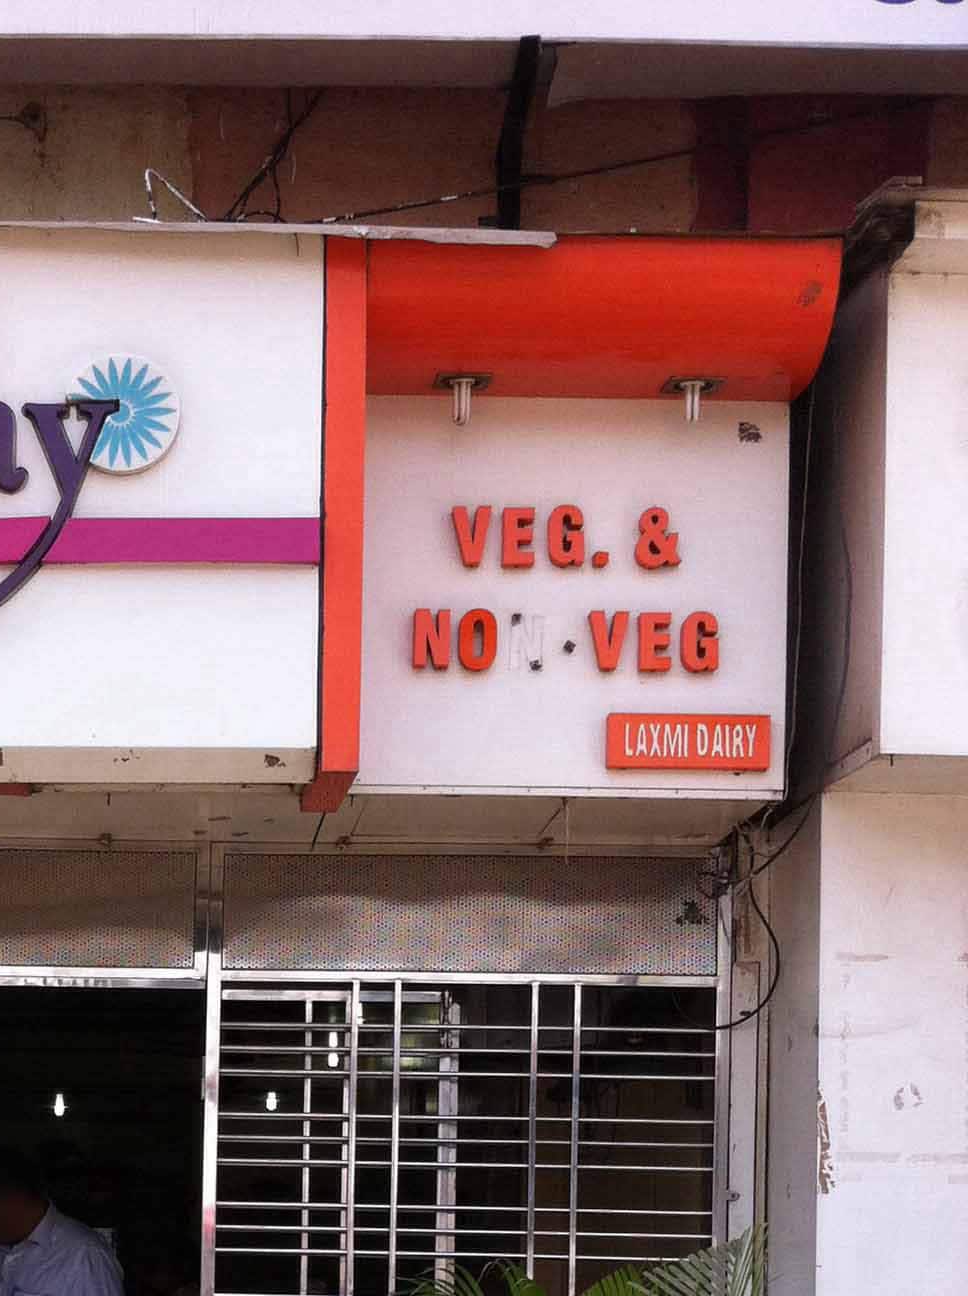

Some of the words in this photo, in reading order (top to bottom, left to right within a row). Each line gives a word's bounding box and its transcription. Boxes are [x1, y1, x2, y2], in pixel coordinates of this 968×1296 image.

[451, 503, 610, 570] VEG.
[633, 506, 682, 571] &
[587, 609, 721, 674] VEG
[623, 722, 689, 759] LAXMI
[696, 722, 758, 759] DAIRY
